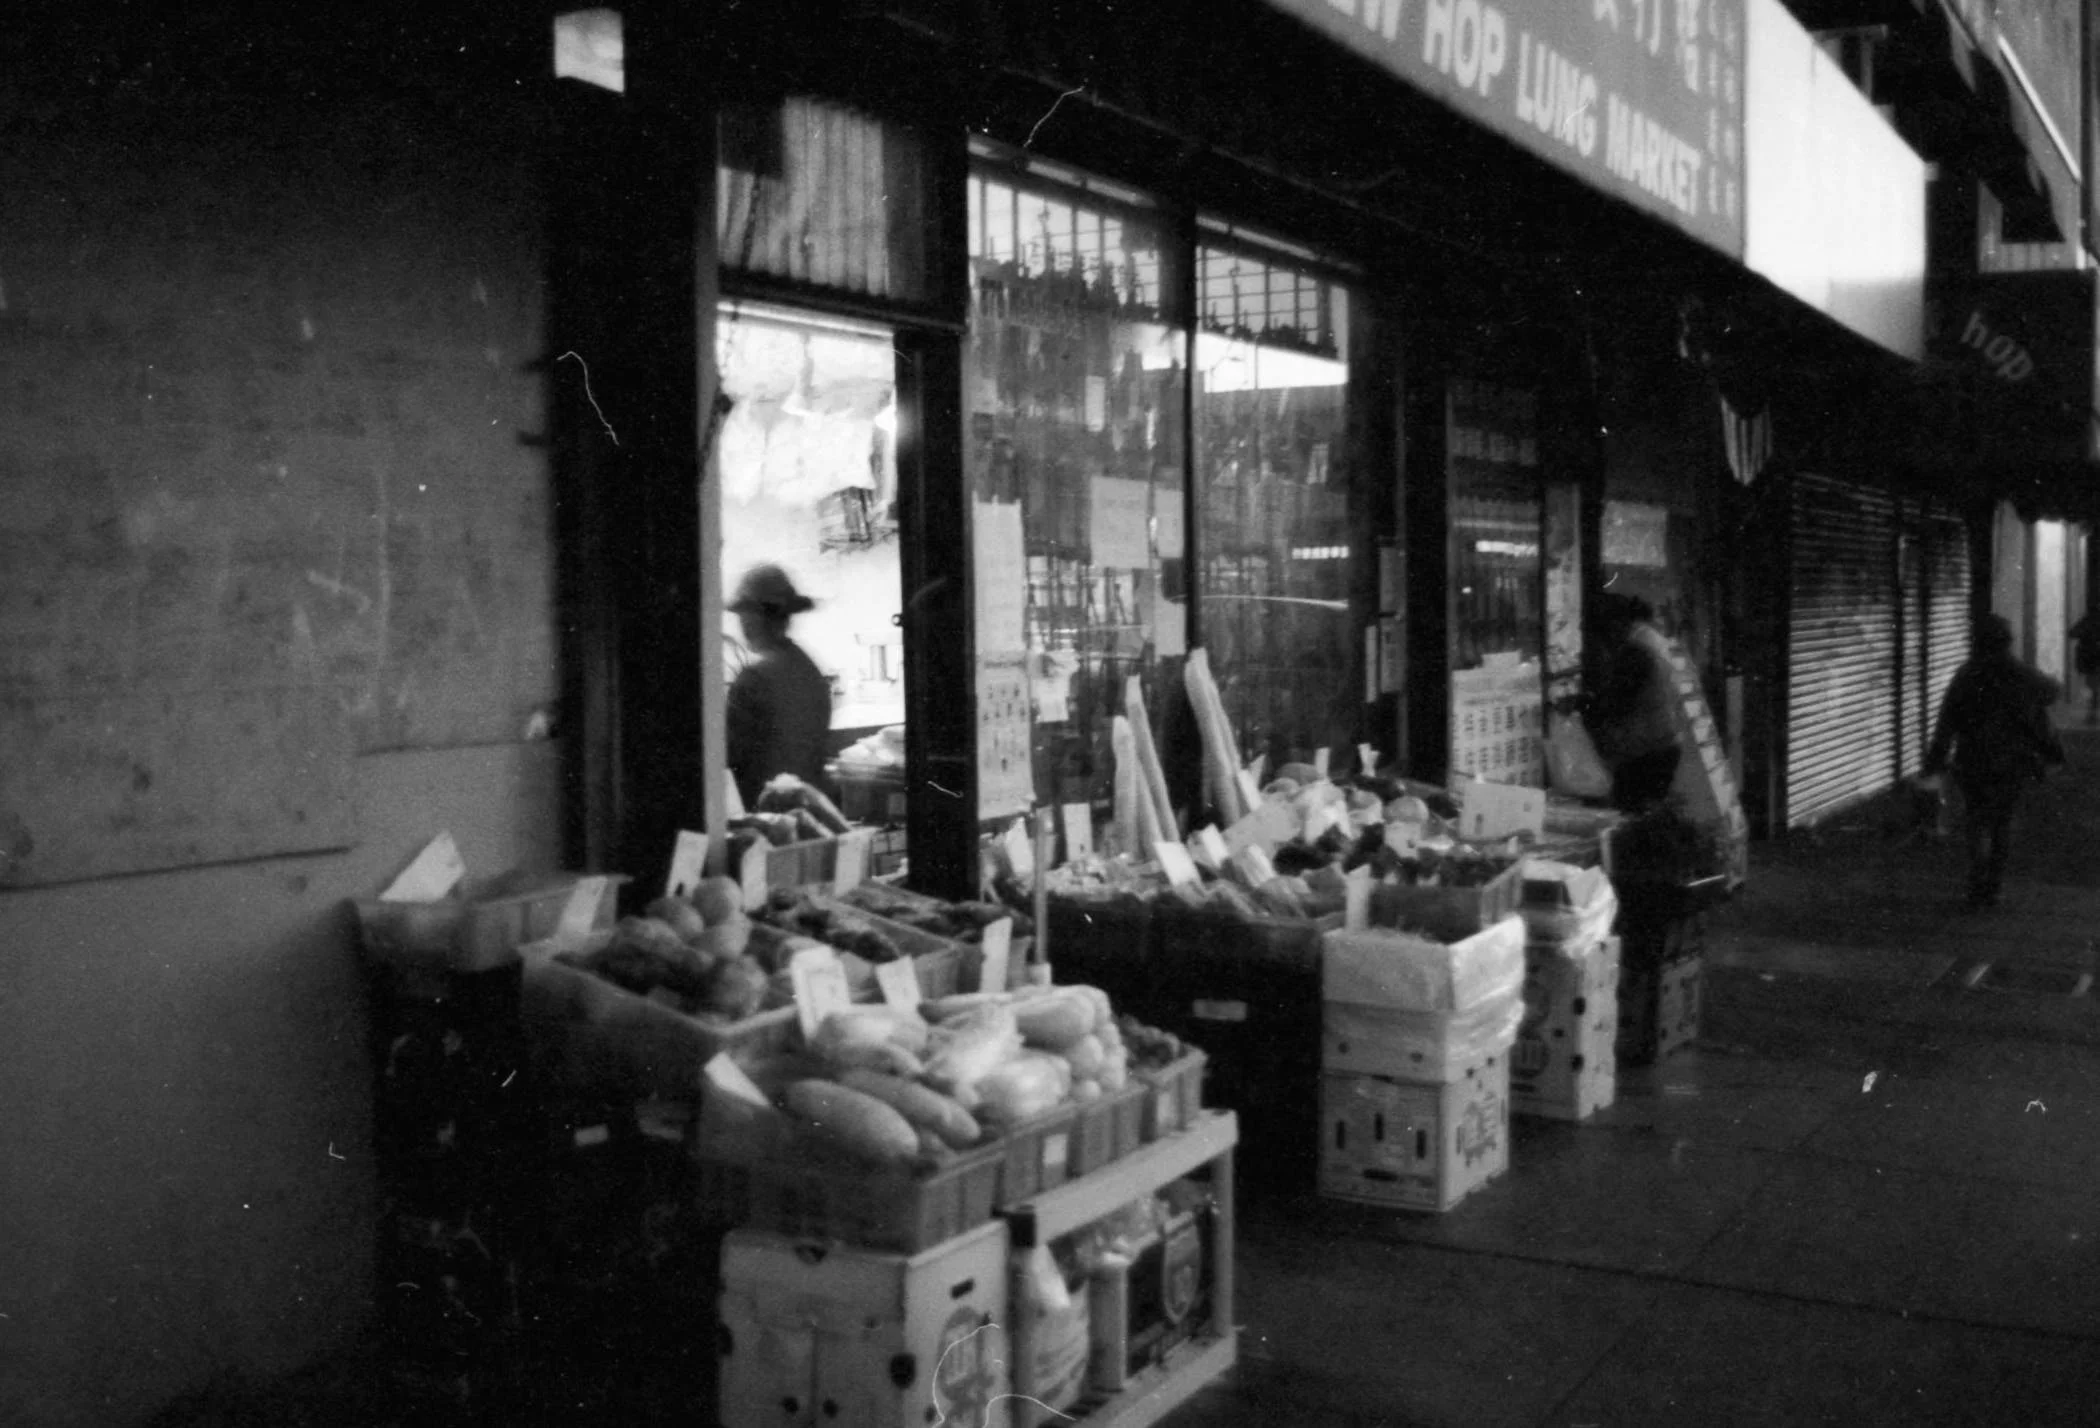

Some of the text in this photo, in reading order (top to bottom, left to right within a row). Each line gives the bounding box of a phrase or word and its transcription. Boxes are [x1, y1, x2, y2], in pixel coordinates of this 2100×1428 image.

[1422, 0, 1506, 97] HOP
[1515, 31, 1598, 157] LUNG
[1606, 92, 1701, 217] MARKET
[1960, 311, 2033, 380] hop
